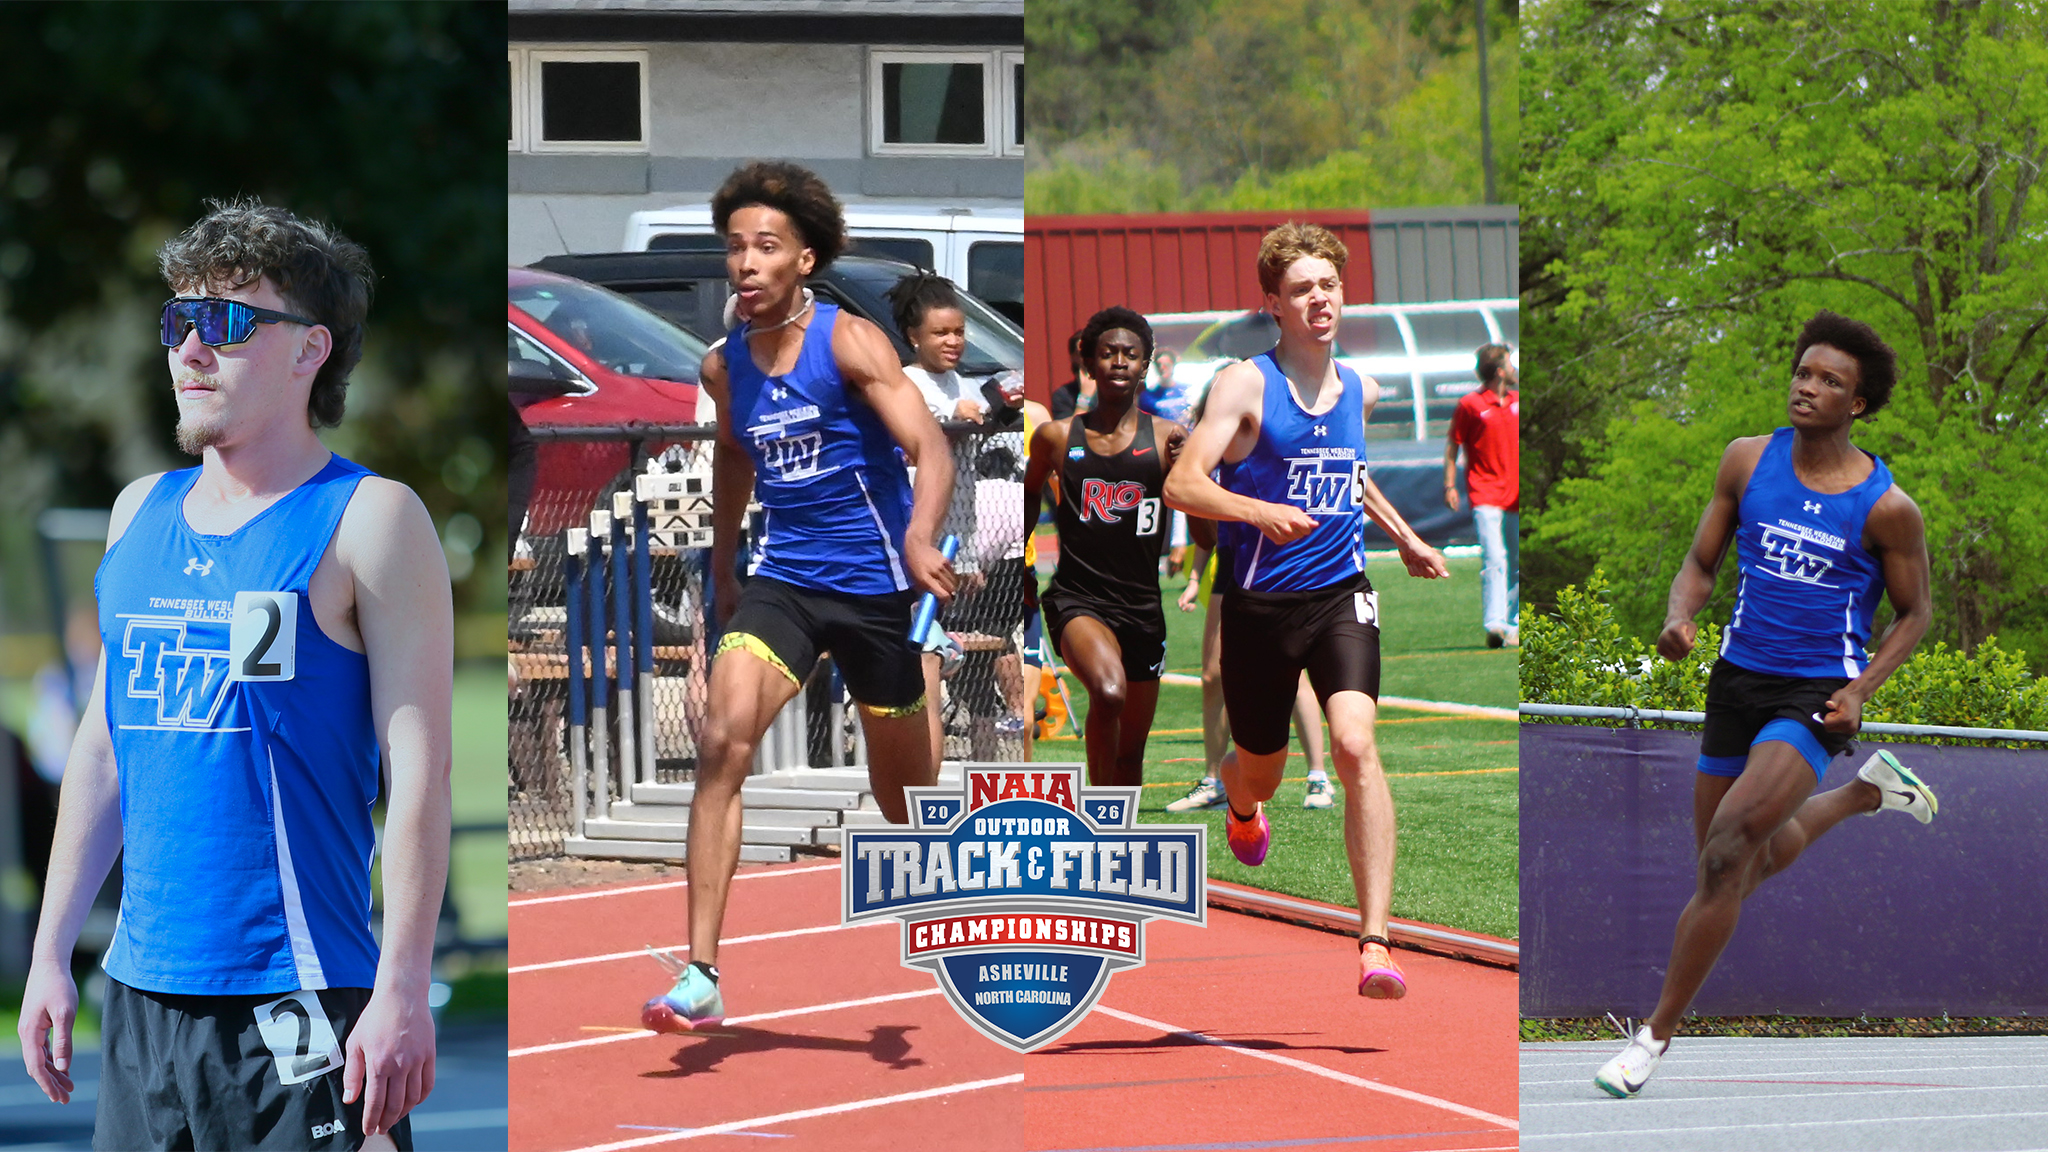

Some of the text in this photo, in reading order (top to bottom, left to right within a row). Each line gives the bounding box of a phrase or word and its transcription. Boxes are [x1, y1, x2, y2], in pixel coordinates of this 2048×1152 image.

[754, 424, 822, 481] TW
[1079, 478, 1147, 523] RIO
[1287, 460, 1350, 512] TW
[1355, 464, 1366, 504] 5
[1141, 501, 1156, 533] 3
[1778, 518, 1814, 533] TENNESSEE
[1761, 527, 1833, 582] TW
[149, 597, 234, 612] TENNESSEE WESL
[184, 609, 234, 620] BULLDO
[242, 596, 281, 677] 2
[122, 619, 232, 728] TW
[270, 998, 331, 1078] 2
[310, 1118, 346, 1140] BOA
